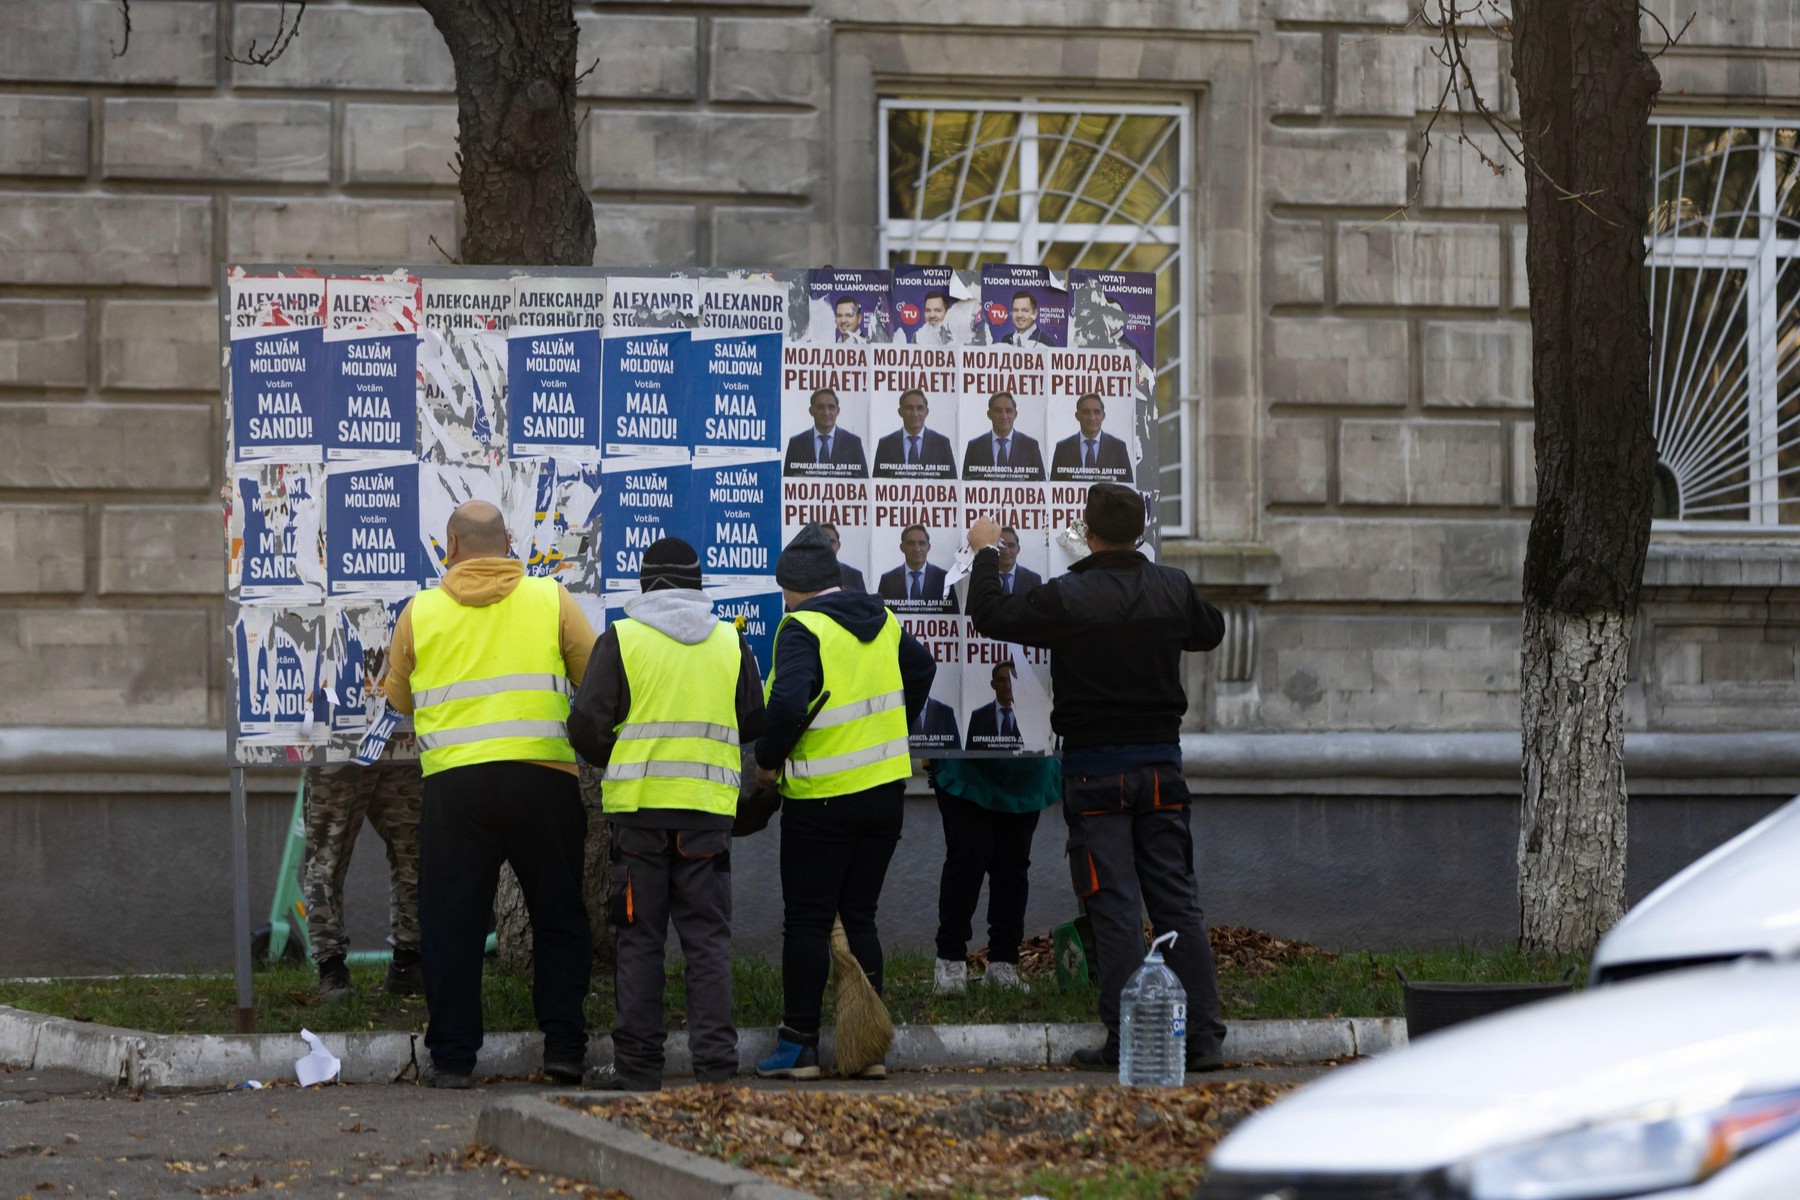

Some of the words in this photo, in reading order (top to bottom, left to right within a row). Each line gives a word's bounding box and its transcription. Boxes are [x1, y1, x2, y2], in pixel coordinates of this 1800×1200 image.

[896, 278, 922, 286] TUDOR
[983, 277, 1009, 286] TUDOR
[426, 294, 511, 311] АЛЕКСАНДР
[519, 292, 604, 309] АЛЕКСАНДР
[704, 292, 783, 312] ALEXANDR
[519, 313, 604, 329] СТОЯНОГЛО
[704, 314, 784, 331] STOIANOGLO
[255, 337, 299, 356] SALVĂM
[348, 342, 391, 360] SALVĂM
[532, 338, 574, 356] SALVĂM
[626, 339, 668, 357] SALVĂM
[714, 340, 757, 359] SALVĂM
[250, 358, 306, 373] MOLDOVA!
[526, 357, 580, 373] MOLDOVA!
[620, 358, 674, 374] MOLDOVA!
[784, 347, 867, 368] МОЛДОВА
[874, 349, 956, 369] МОЛДОВА
[963, 351, 1045, 372] МОЛДОВА
[1051, 352, 1132, 373] МОЛДОВА
[342, 362, 397, 377] MOLDOVA!
[709, 360, 762, 376] MOLDOVA!
[266, 380, 293, 389] Votăm
[357, 383, 384, 393] Votăm
[540, 379, 567, 388] Votăm
[634, 380, 661, 389] Votăm
[723, 381, 749, 391] Votăm
[785, 369, 867, 392] РЕШАЕТ!
[874, 371, 956, 393] РЕШАЕТ!
[963, 373, 1044, 396] РЕШАЕТ!
[1051, 374, 1132, 397] РЕШАЕТ!
[258, 393, 303, 415] MAIA
[348, 396, 391, 419] MAIA
[532, 392, 575, 414] MAIA
[626, 392, 668, 415] MAIA
[714, 394, 757, 417] MAIA
[249, 416, 313, 440] SANDU!
[338, 420, 400, 444] SANDU!
[523, 416, 585, 439] SANDU!
[616, 416, 677, 440] SANDU!
[705, 418, 766, 441] SANDU!
[835, 463, 848, 472] ДЛЯ
[925, 464, 936, 472] ДЛЯ
[1014, 466, 1025, 475] ДЛЯ
[1102, 467, 1113, 476] ДЛЯ
[350, 473, 393, 491] SALVĂM
[625, 473, 667, 490] SALVĂM
[715, 471, 758, 486] SALVĂM
[345, 493, 401, 508] MOLDOVA!
[619, 492, 673, 508] MOLDOVA!
[709, 488, 764, 504] MOLDOVA!
[784, 483, 868, 503] МОЛДОВА
[876, 485, 957, 505] МОЛДОВА
[965, 487, 1046, 507] МОЛДОВА
[360, 515, 387, 524] Votăm
[633, 514, 660, 523] Votăm
[724, 509, 751, 519] Votăm
[785, 505, 868, 526] РЕШАЕТ!
[876, 507, 958, 527] РЕШАЕТ!
[352, 528, 396, 550] MAIA
[716, 522, 759, 544] MAIA
[343, 553, 406, 574] SANDU!
[706, 546, 768, 569] SANDU!
[717, 601, 760, 619] SALVĂM
